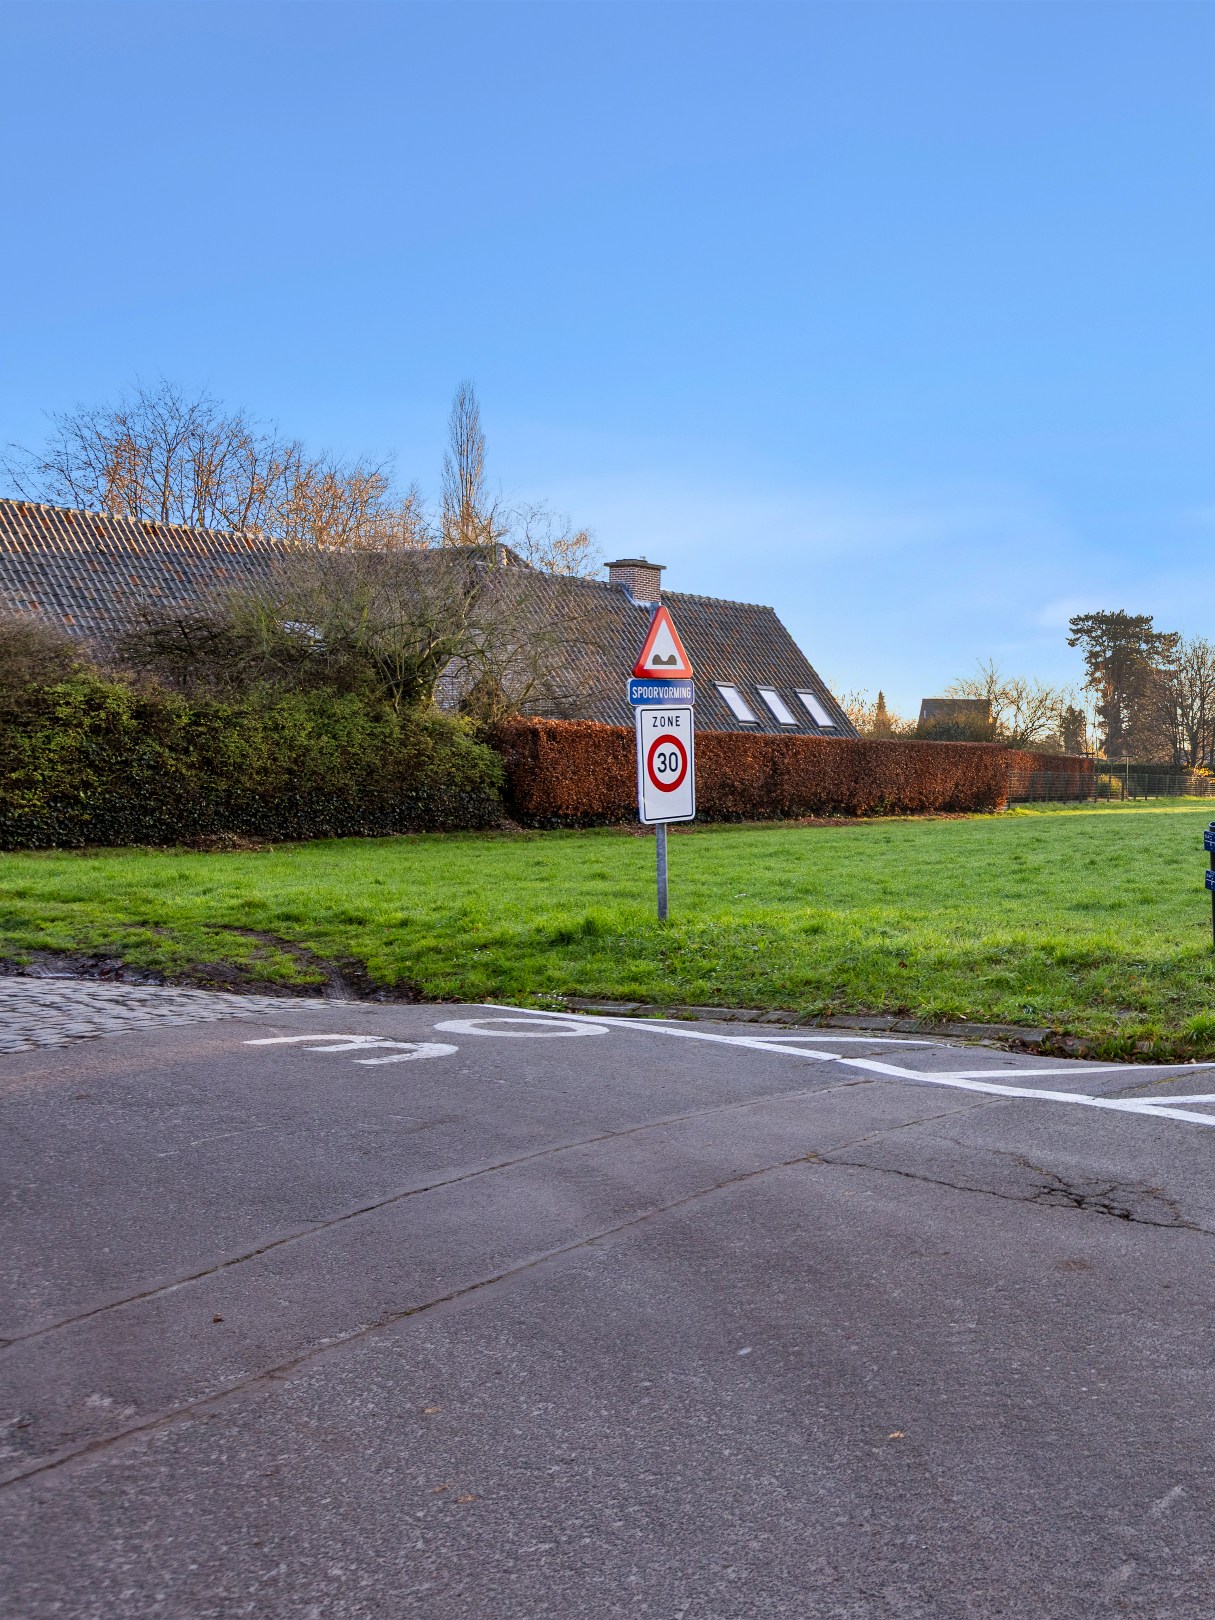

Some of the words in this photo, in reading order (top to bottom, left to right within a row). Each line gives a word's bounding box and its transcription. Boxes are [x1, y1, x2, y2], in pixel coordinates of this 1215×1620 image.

[632, 686, 691, 699] SPOORVORMING
[652, 715, 681, 728] ZONE
[657, 751, 679, 773] 30
